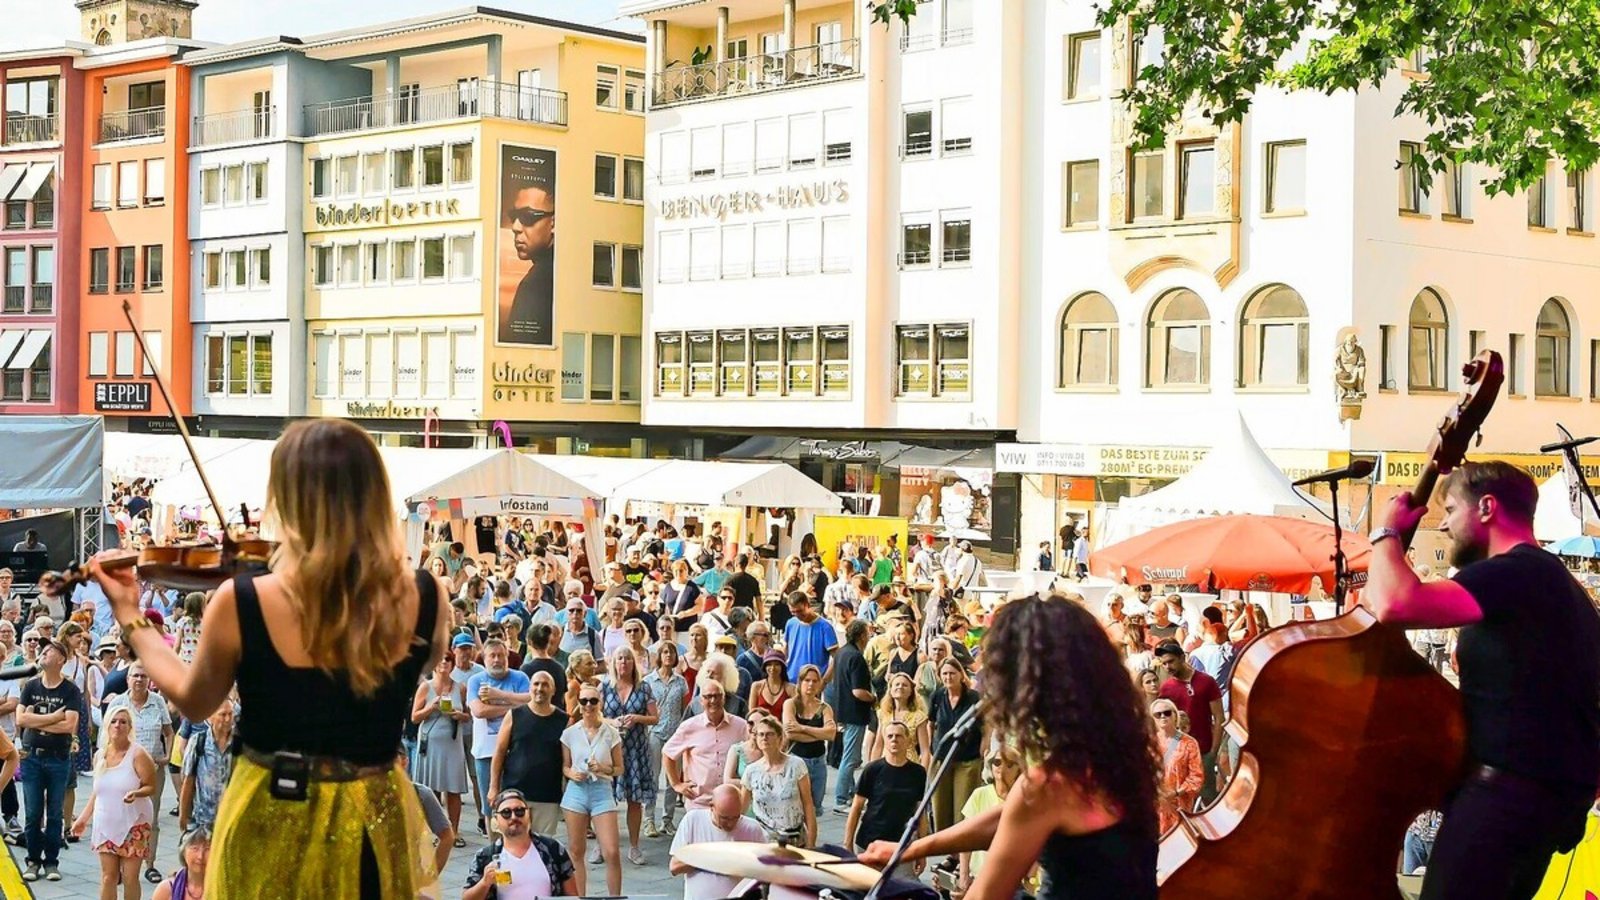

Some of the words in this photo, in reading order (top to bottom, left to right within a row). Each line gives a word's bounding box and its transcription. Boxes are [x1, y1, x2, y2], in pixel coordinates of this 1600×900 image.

[512, 155, 545, 164] OAKLEY
[316, 203, 382, 226] binder
[392, 198, 460, 219] OPTIK
[492, 361, 556, 383] binder
[109, 384, 148, 402] EPPLI
[493, 388, 554, 402] OPTIK
[1001, 452, 1027, 465] VIW
[1100, 449, 1123, 460] DAS
[1126, 449, 1160, 460] BESTE
[1163, 451, 1189, 461] ZUM
[1387, 463, 1410, 477] DAS
[500, 500, 549, 511] Infostand
